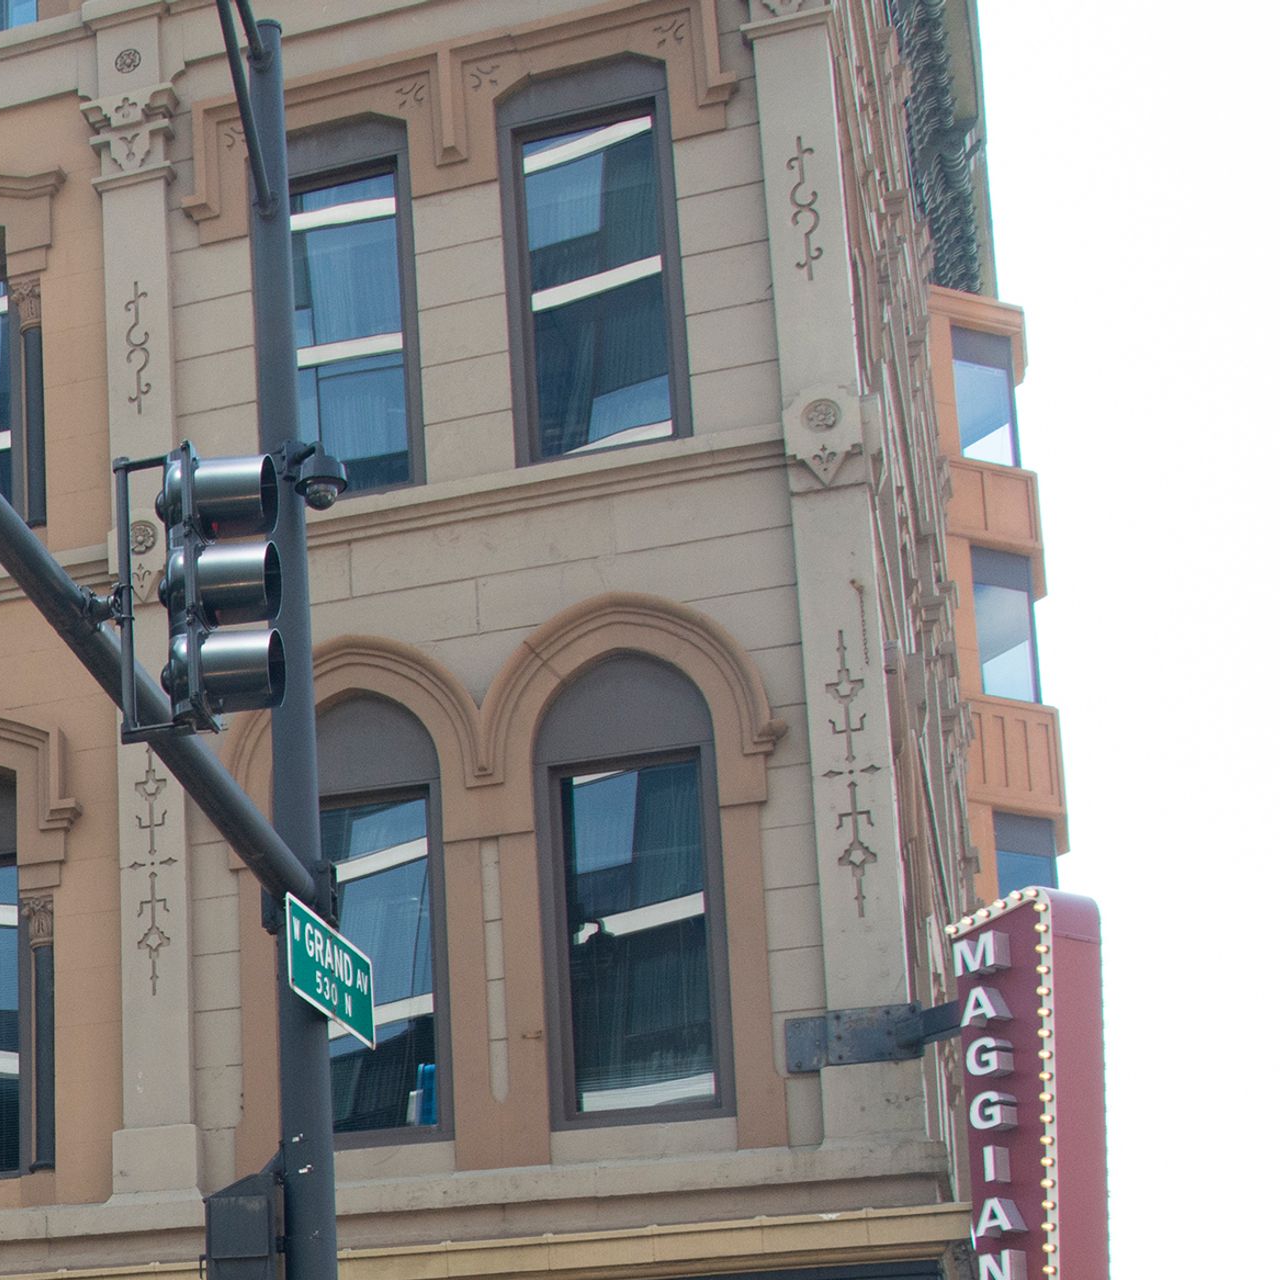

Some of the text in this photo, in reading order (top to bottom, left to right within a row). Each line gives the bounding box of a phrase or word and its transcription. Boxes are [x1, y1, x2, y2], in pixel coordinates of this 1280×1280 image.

[292, 916, 368, 995] W GRAND AV
[316, 970, 352, 1017] 530 N
